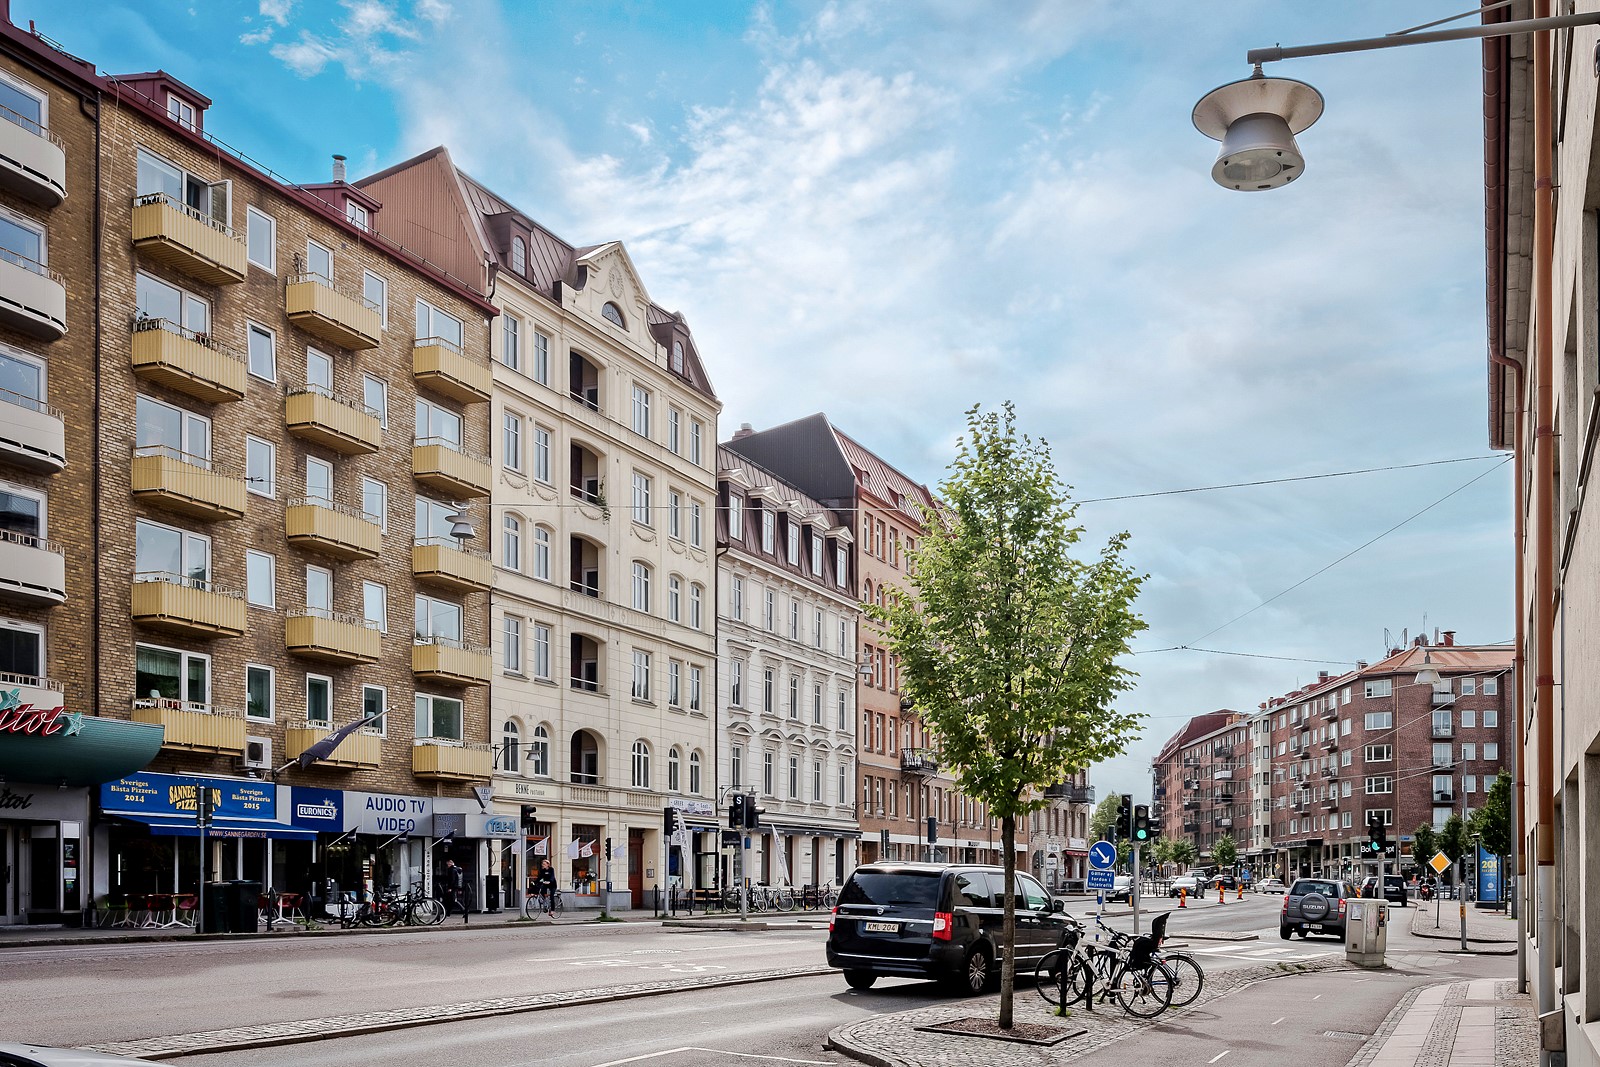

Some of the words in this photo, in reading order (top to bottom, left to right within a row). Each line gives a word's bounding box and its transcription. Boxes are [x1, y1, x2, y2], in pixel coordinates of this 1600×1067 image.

[120, 779, 149, 787] Sveriges
[131, 787, 158, 795] Pizzeria
[169, 783, 221, 807] SANNEGNS
[239, 788, 263, 796] Sveriges
[124, 795, 145, 803] 2014
[248, 795, 271, 803] Pizzeria
[243, 802, 260, 810] 2015
[366, 797, 406, 812] AUDIO
[410, 800, 425, 814] TV
[299, 806, 333, 817] EURONICS
[376, 817, 415, 832] VIDEO
